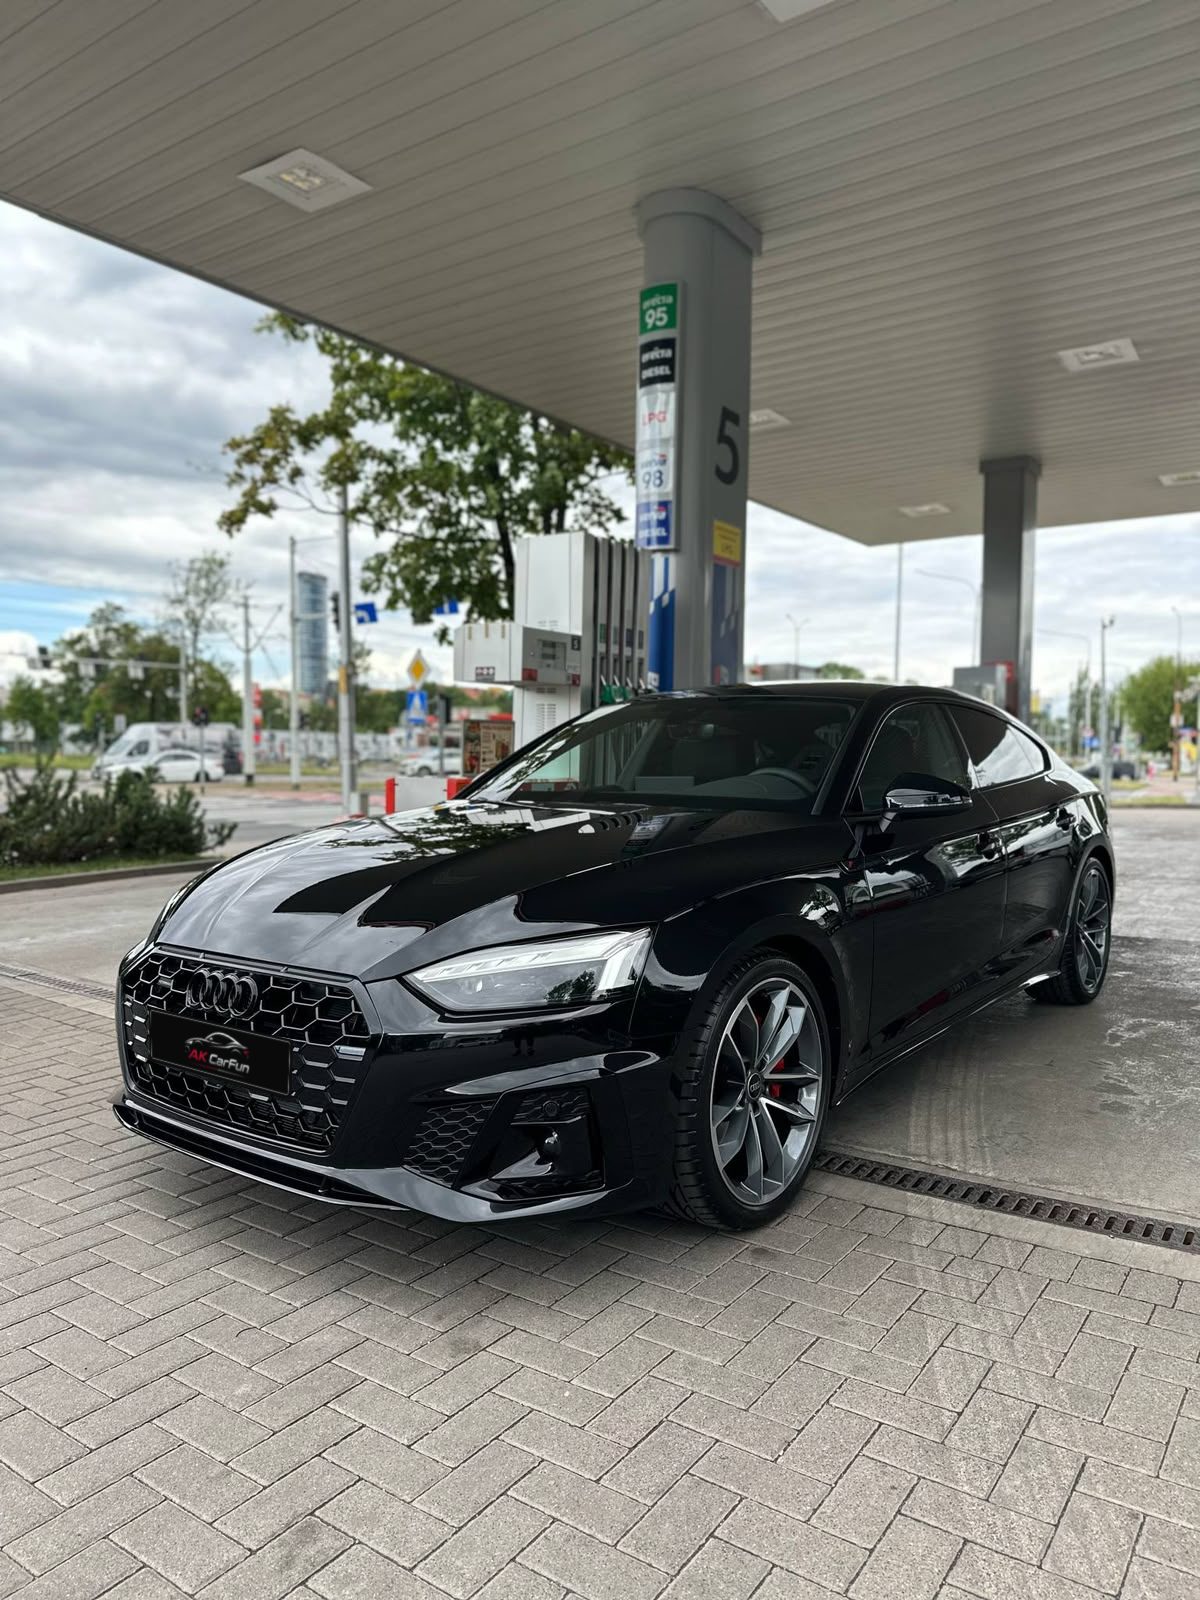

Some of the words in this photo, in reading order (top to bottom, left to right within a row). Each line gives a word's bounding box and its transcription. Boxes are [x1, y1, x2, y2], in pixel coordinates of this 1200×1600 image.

[645, 306, 668, 329] 95
[642, 411, 667, 426] LPG
[714, 405, 741, 485] 5
[642, 470, 664, 489] 98
[188, 1048, 208, 1063] AK
[209, 1053, 250, 1074] CarFun
